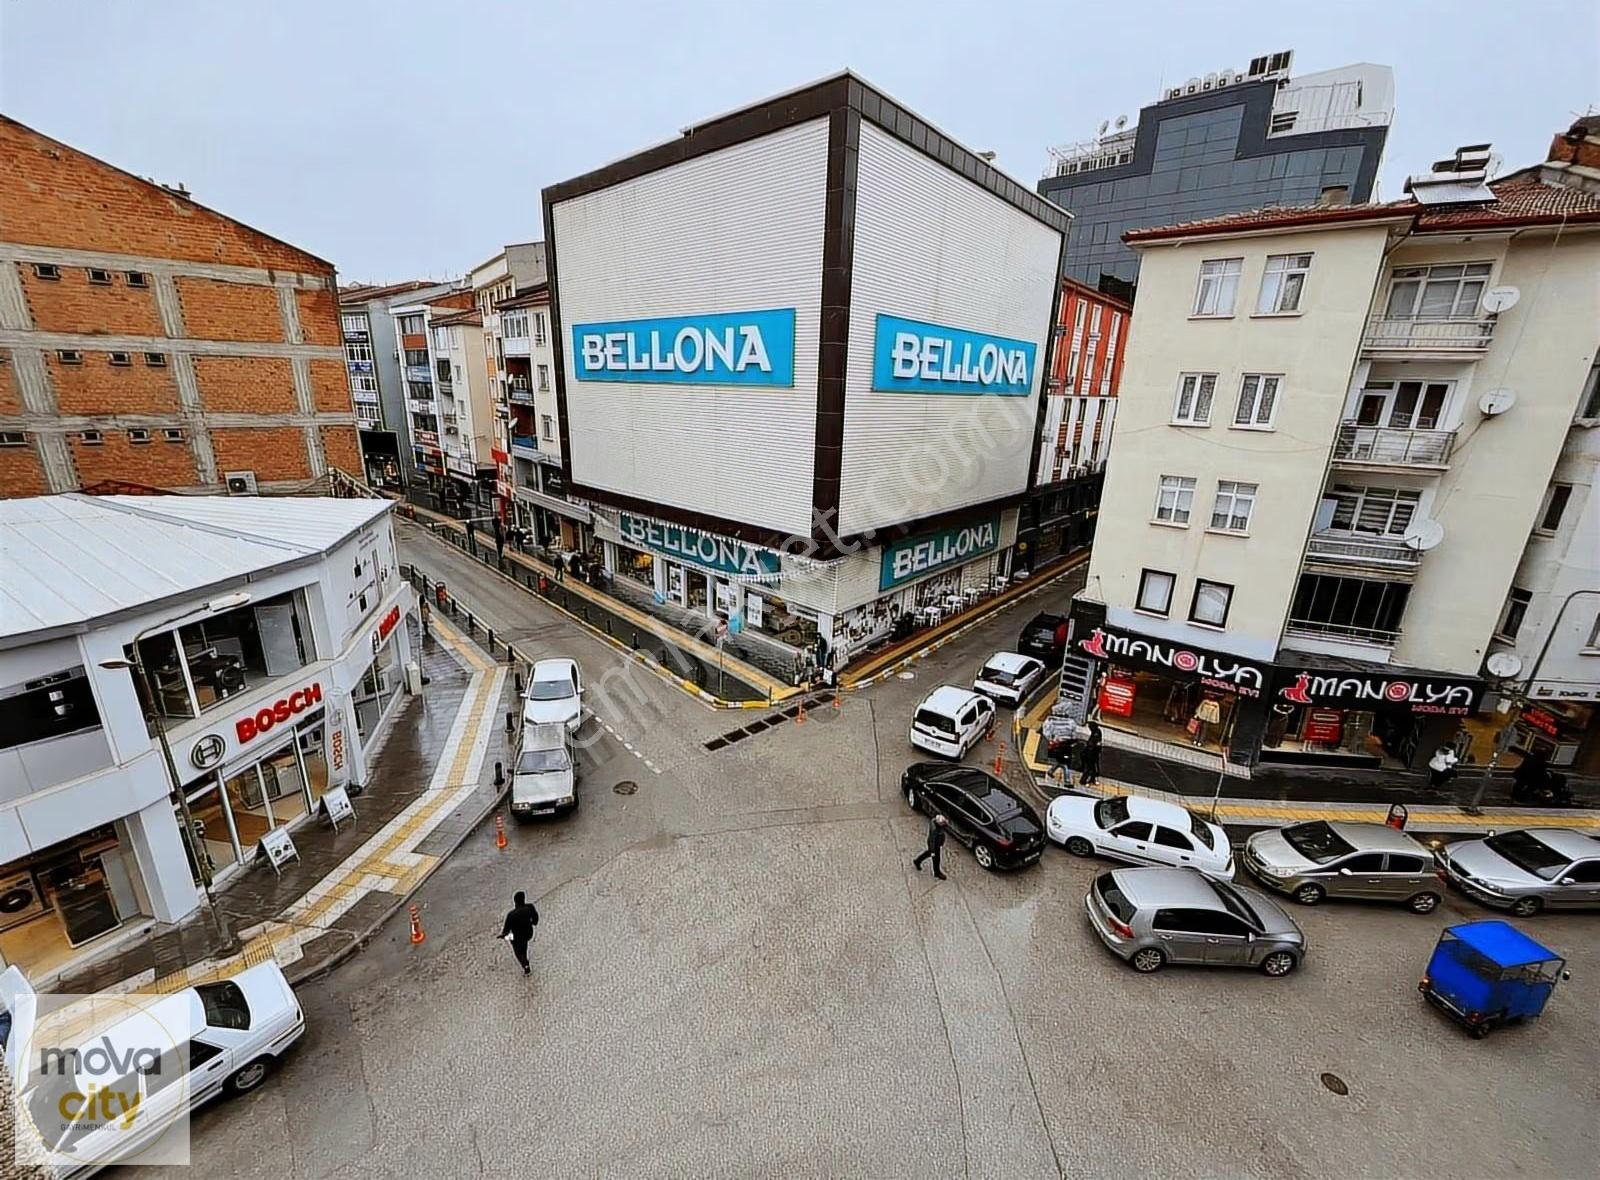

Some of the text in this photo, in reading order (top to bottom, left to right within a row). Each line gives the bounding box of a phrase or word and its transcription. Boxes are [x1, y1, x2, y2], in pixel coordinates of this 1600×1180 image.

[582, 325, 772, 372] BELLONA
[892, 332, 1027, 385] BELLONA
[627, 515, 762, 575] BELLONA
[893, 522, 994, 579] BELLONA
[1106, 634, 1263, 688] MANOLYA
[236, 682, 322, 744] BOSCH
[1311, 676, 1473, 705] MANOLYA
[332, 730, 344, 771] BOSCH
